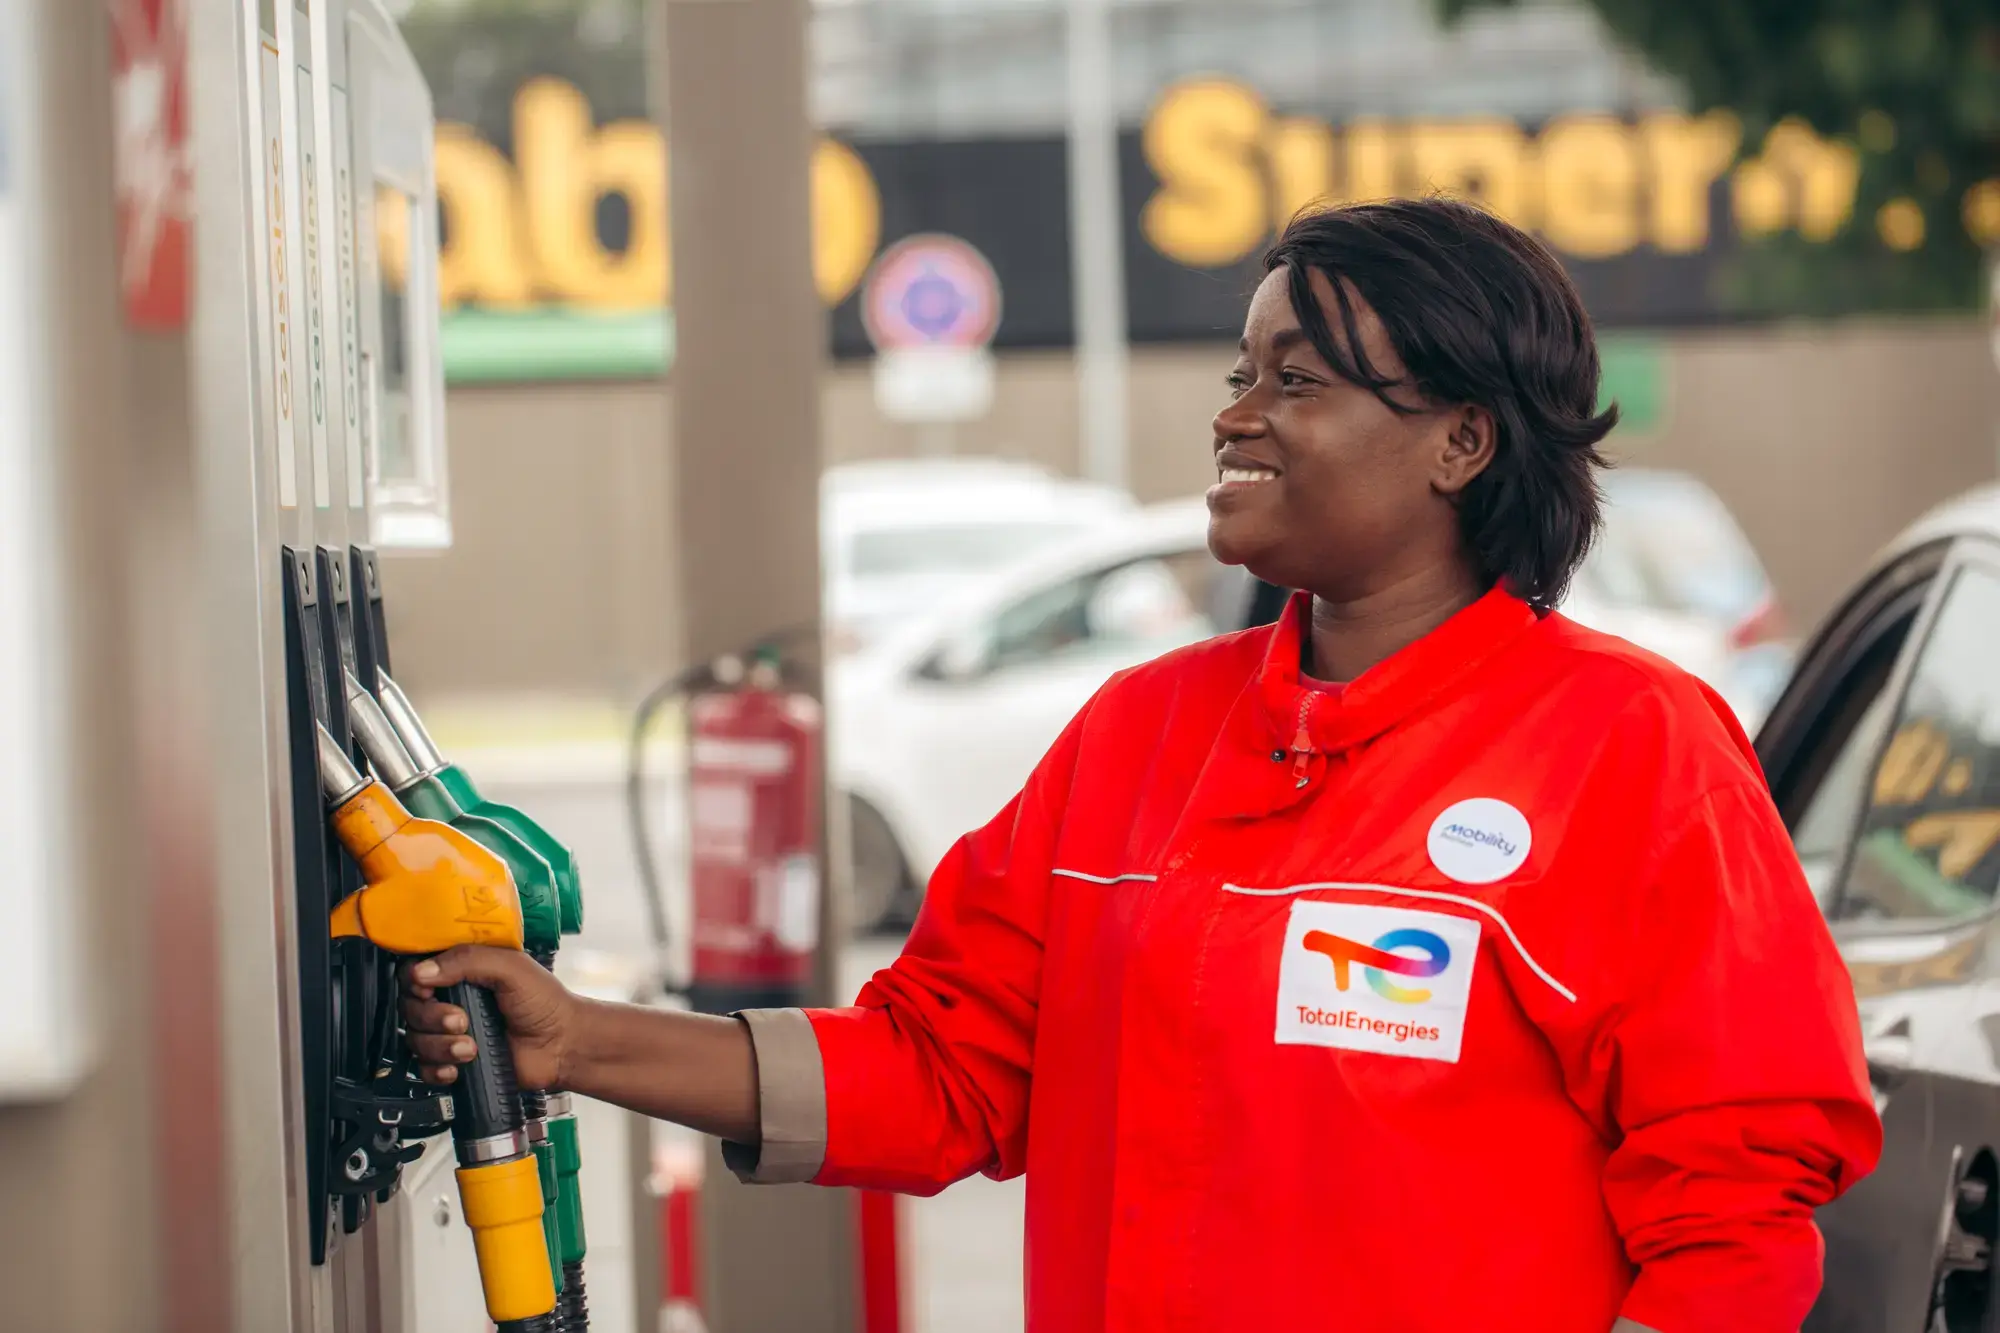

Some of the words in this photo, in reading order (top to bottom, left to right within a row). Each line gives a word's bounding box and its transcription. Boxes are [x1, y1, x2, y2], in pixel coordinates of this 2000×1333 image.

[306, 152, 322, 426] Gasolina
[340, 167, 356, 429] Gasolina
[1443, 823, 1517, 857] Mobility
[1296, 1005, 1440, 1042] TotalEnergies
